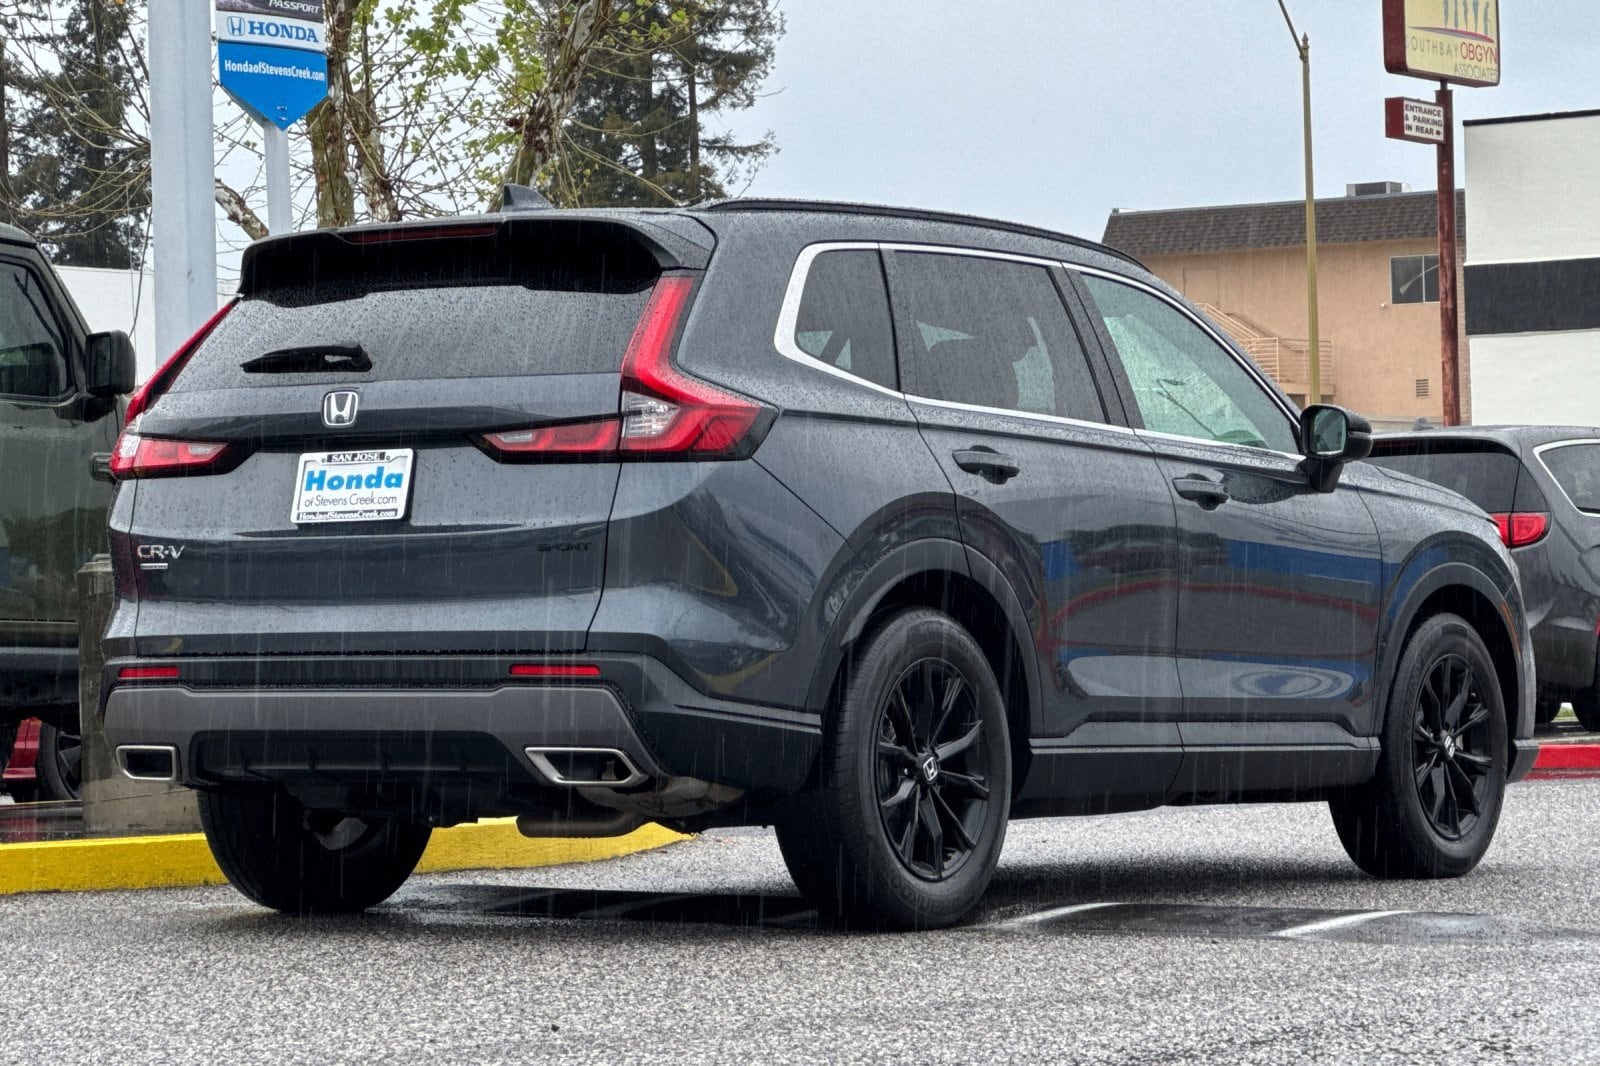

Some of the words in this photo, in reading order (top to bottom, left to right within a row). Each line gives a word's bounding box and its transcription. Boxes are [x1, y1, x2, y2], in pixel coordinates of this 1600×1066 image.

[269, 0, 320, 14] PASSPORT
[247, 20, 319, 43] HONDA
[1460, 42, 1498, 64] OBGYN
[224, 59, 325, 81] HondaofStevensCreek.com
[1404, 104, 1442, 118] ENTRANCE
[1404, 113, 1409, 121] &
[1412, 115, 1443, 127] PARKING
[1405, 123, 1413, 132] IN
[1415, 125, 1434, 136] REAR
[331, 453, 352, 463] SAN
[354, 451, 380, 461] JOSE
[305, 466, 404, 491] Honda
[304, 497, 314, 507] of
[315, 494, 348, 507] Stevens
[349, 491, 398, 506] Creek.com
[137, 544, 186, 560] CR-V
